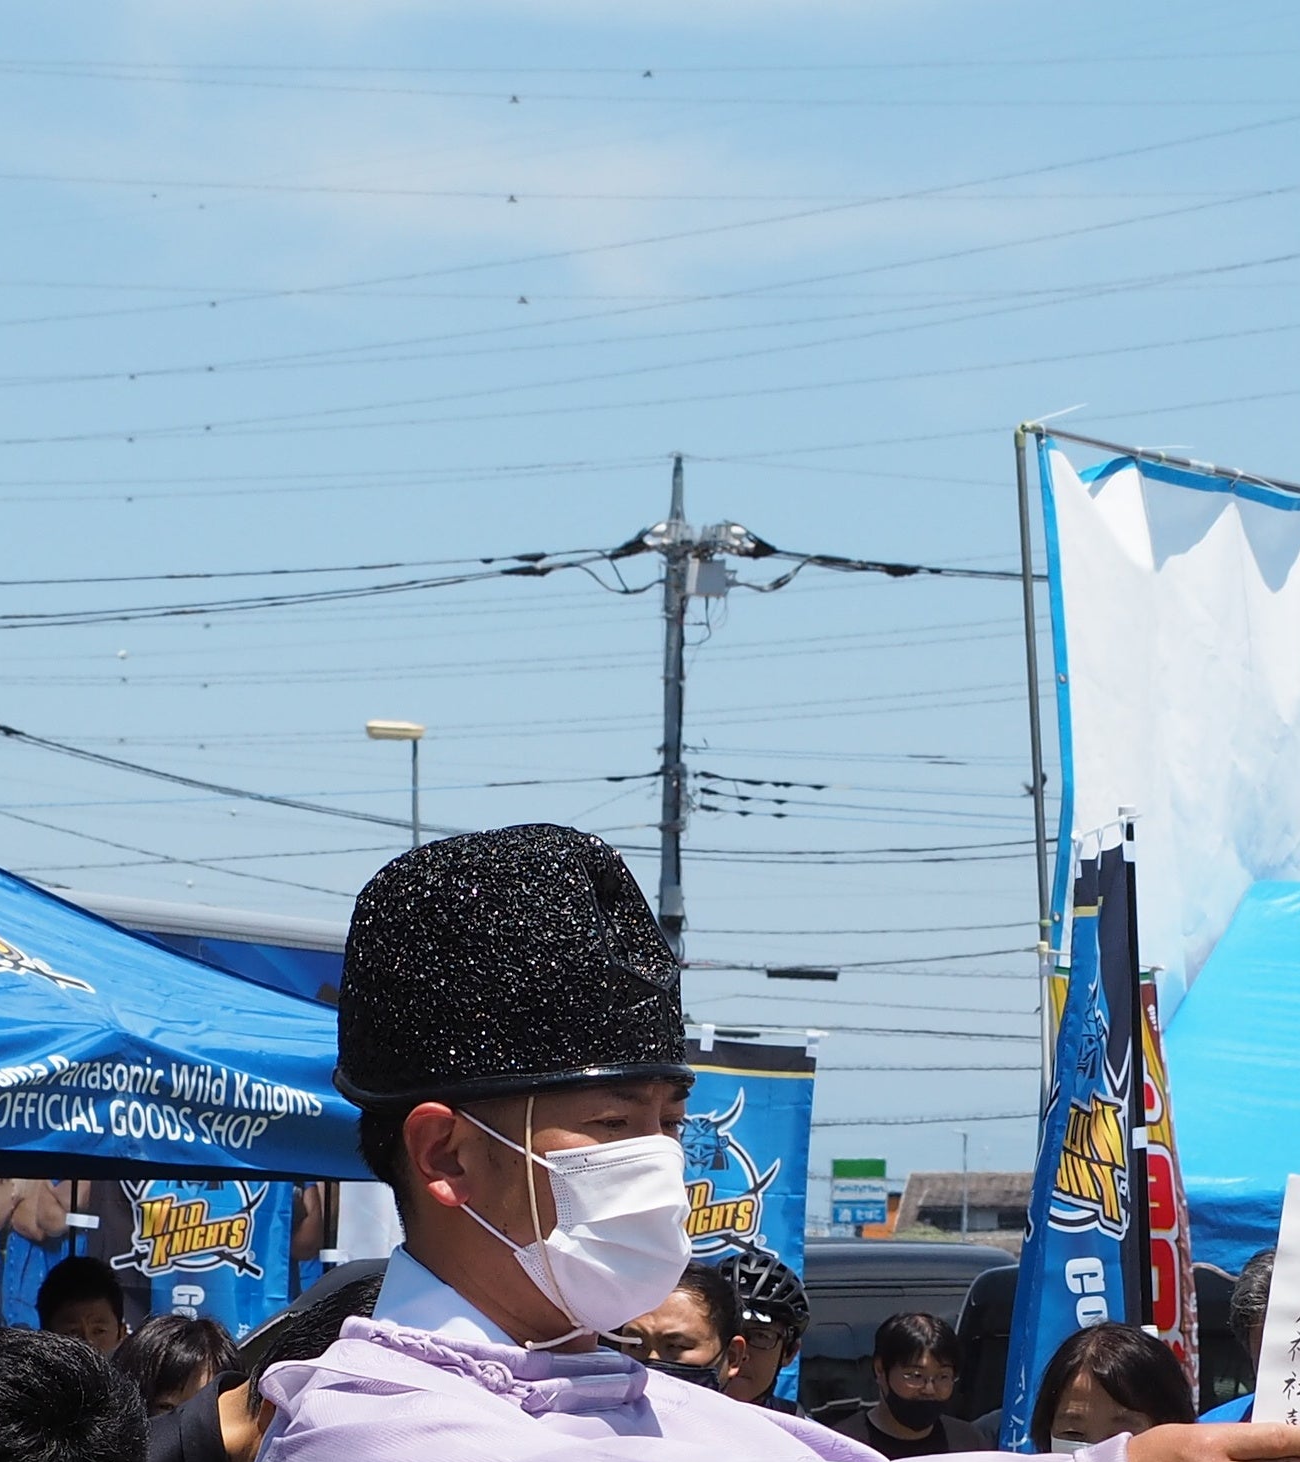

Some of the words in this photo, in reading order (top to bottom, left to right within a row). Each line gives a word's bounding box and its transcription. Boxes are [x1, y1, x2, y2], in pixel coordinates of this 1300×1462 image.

[48, 1054, 164, 1096] Panasonic
[170, 1062, 228, 1107] Wild
[233, 1071, 323, 1120] Knights
[109, 1099, 196, 1143] GOODS
[196, 1111, 269, 1150] SHOP
[138, 1198, 204, 1240] WILD
[149, 1216, 247, 1268] KNIGHTS
[683, 1198, 755, 1237] IGHTS
